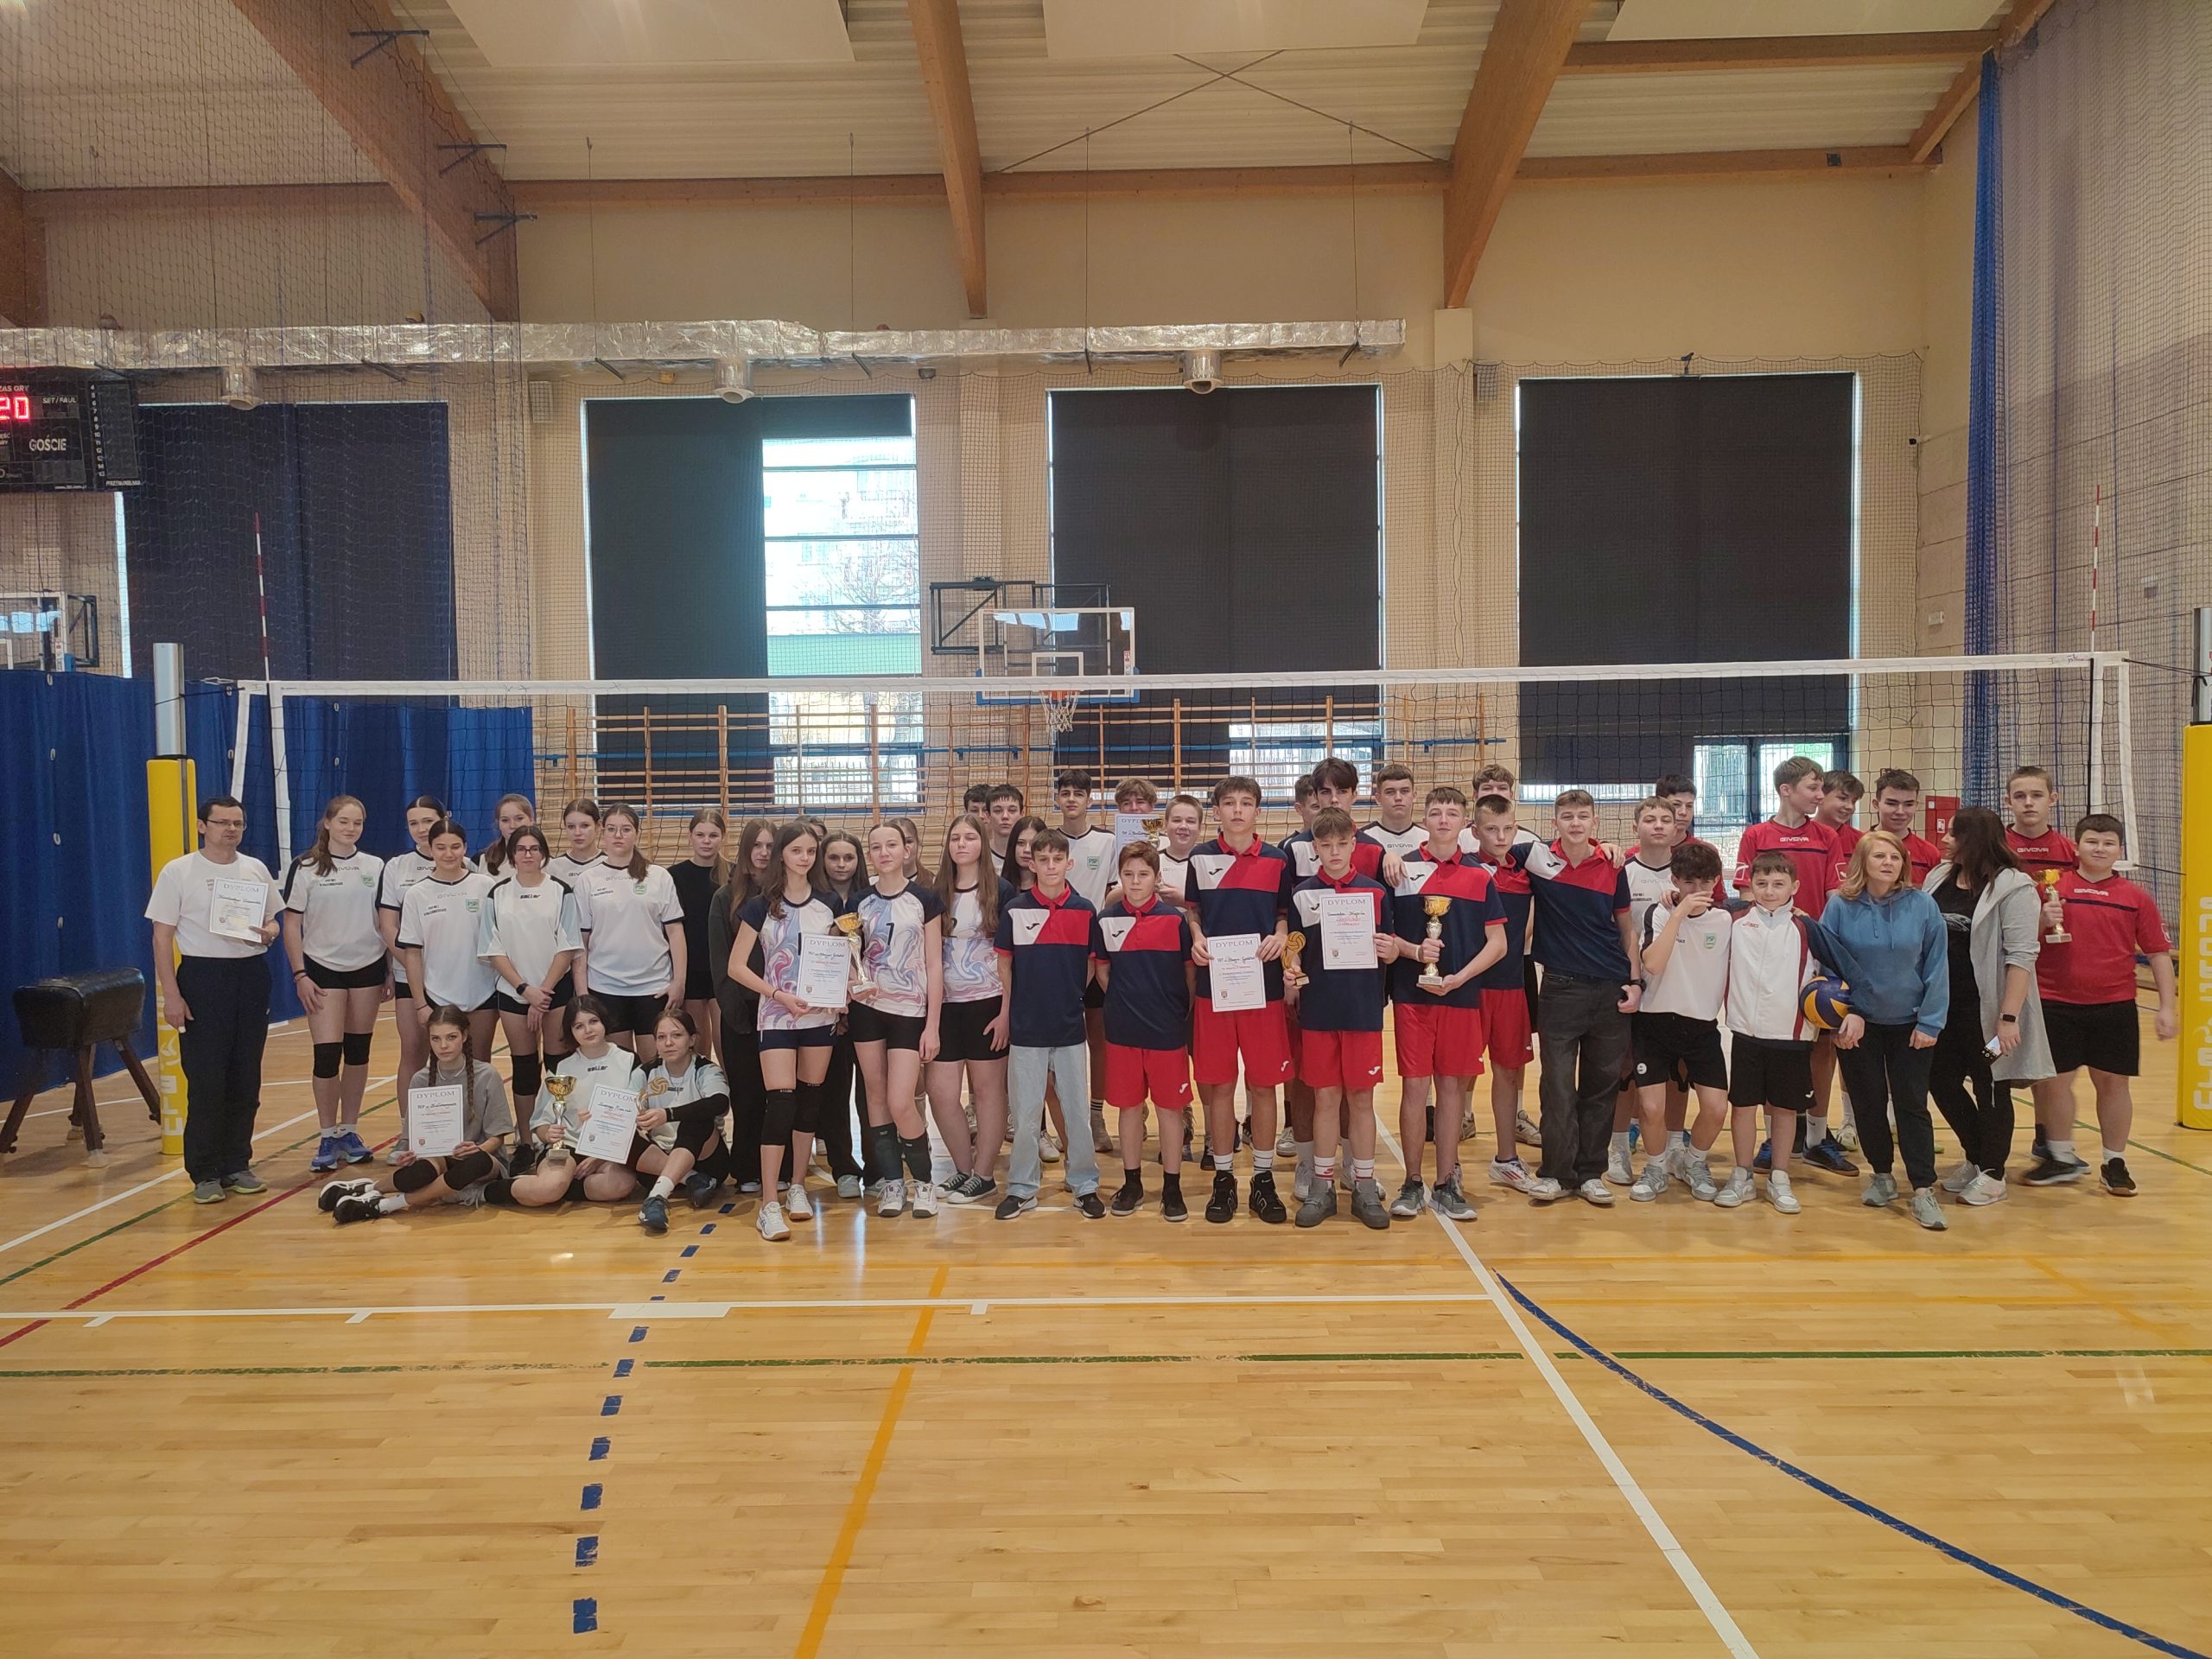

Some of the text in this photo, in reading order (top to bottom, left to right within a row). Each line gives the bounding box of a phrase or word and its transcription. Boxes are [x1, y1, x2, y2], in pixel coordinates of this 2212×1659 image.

[29, 435, 67, 451] GOŚCIE
[810, 939, 846, 948] DYPLOM
[1216, 939, 1253, 948] DYPLOM
[416, 1090, 455, 1099] DYPLOM
